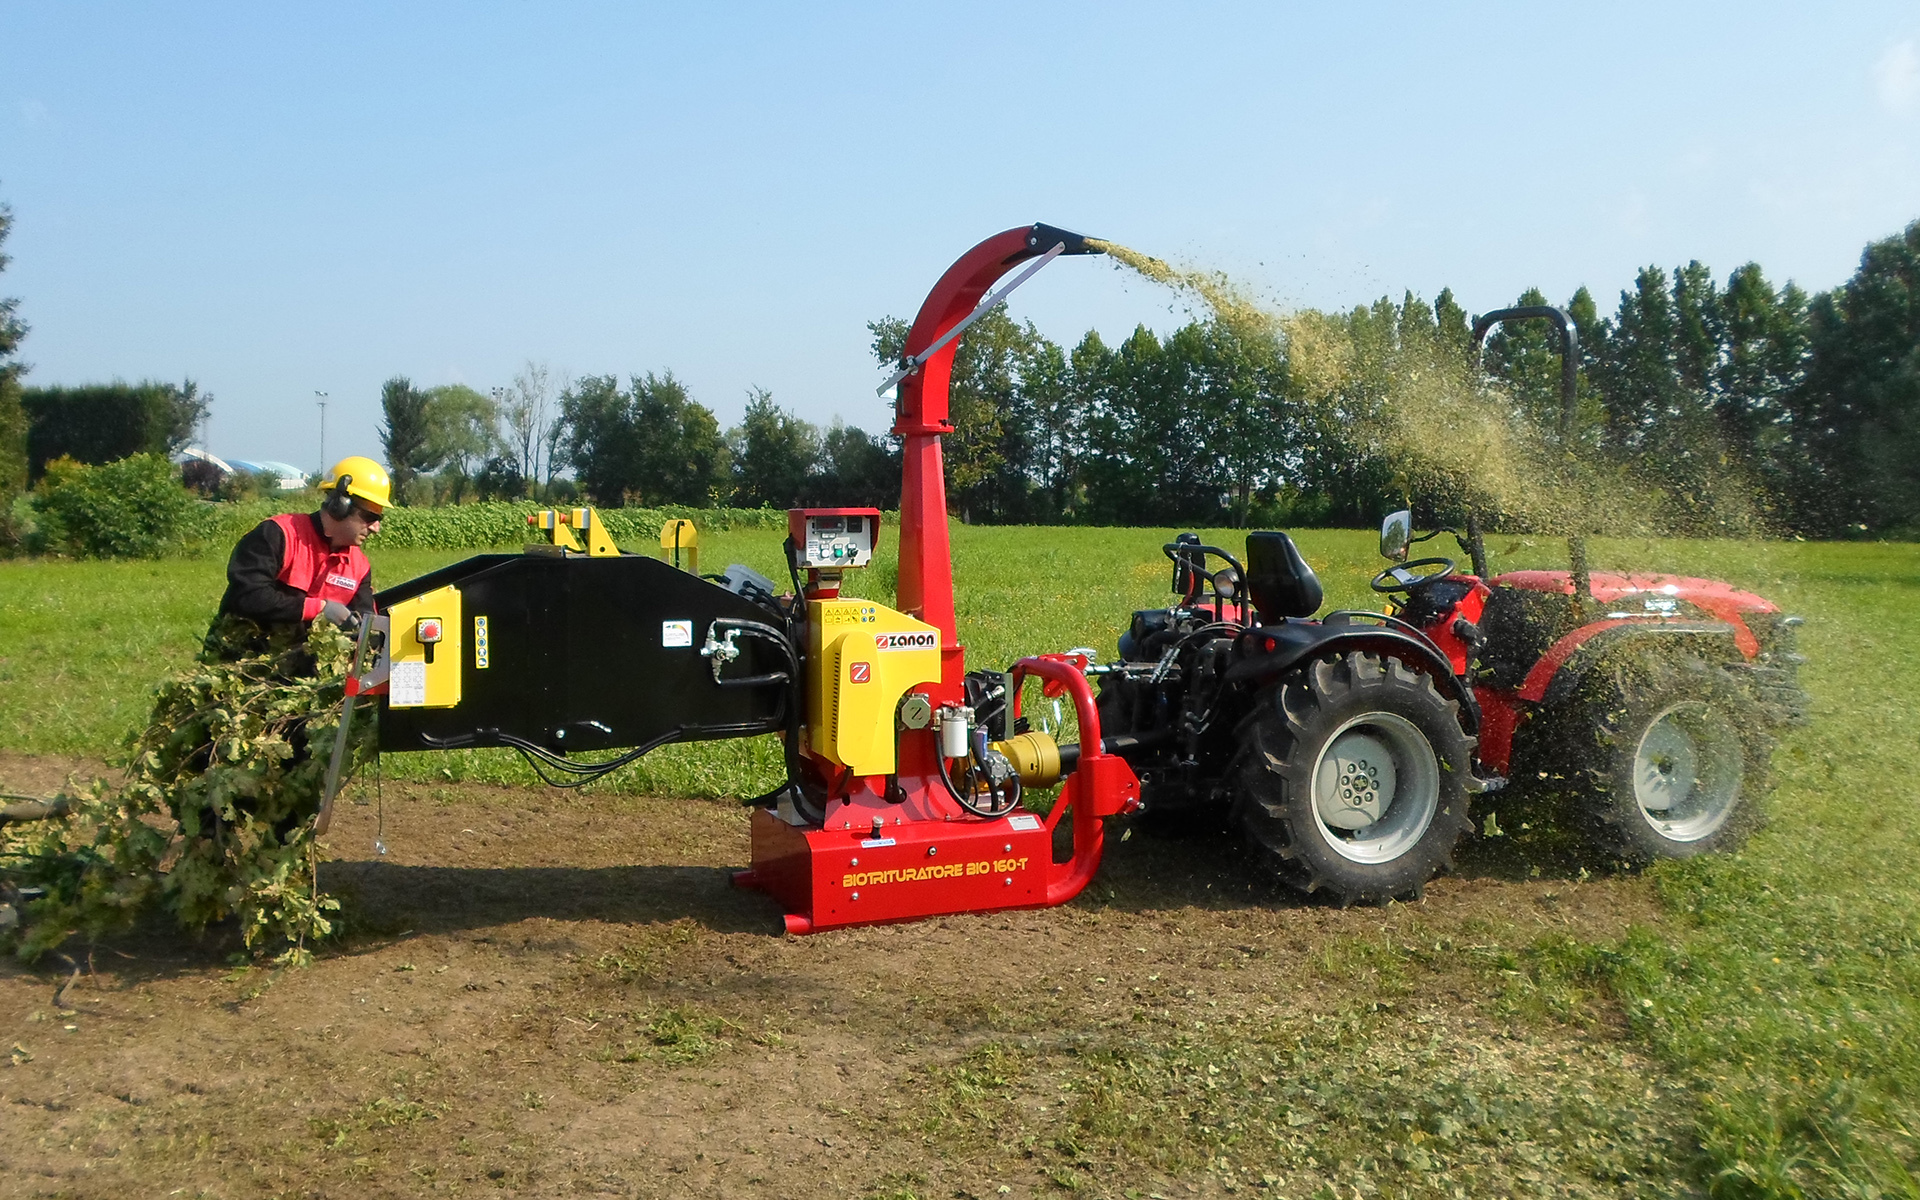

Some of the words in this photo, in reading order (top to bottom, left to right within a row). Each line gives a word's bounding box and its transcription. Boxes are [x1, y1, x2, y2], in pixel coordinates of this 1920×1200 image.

[852, 664, 869, 681] Z
[843, 864, 963, 888] BIOTRITURATORE
[966, 861, 990, 876] BIO
[993, 858, 1028, 873] 160-T
